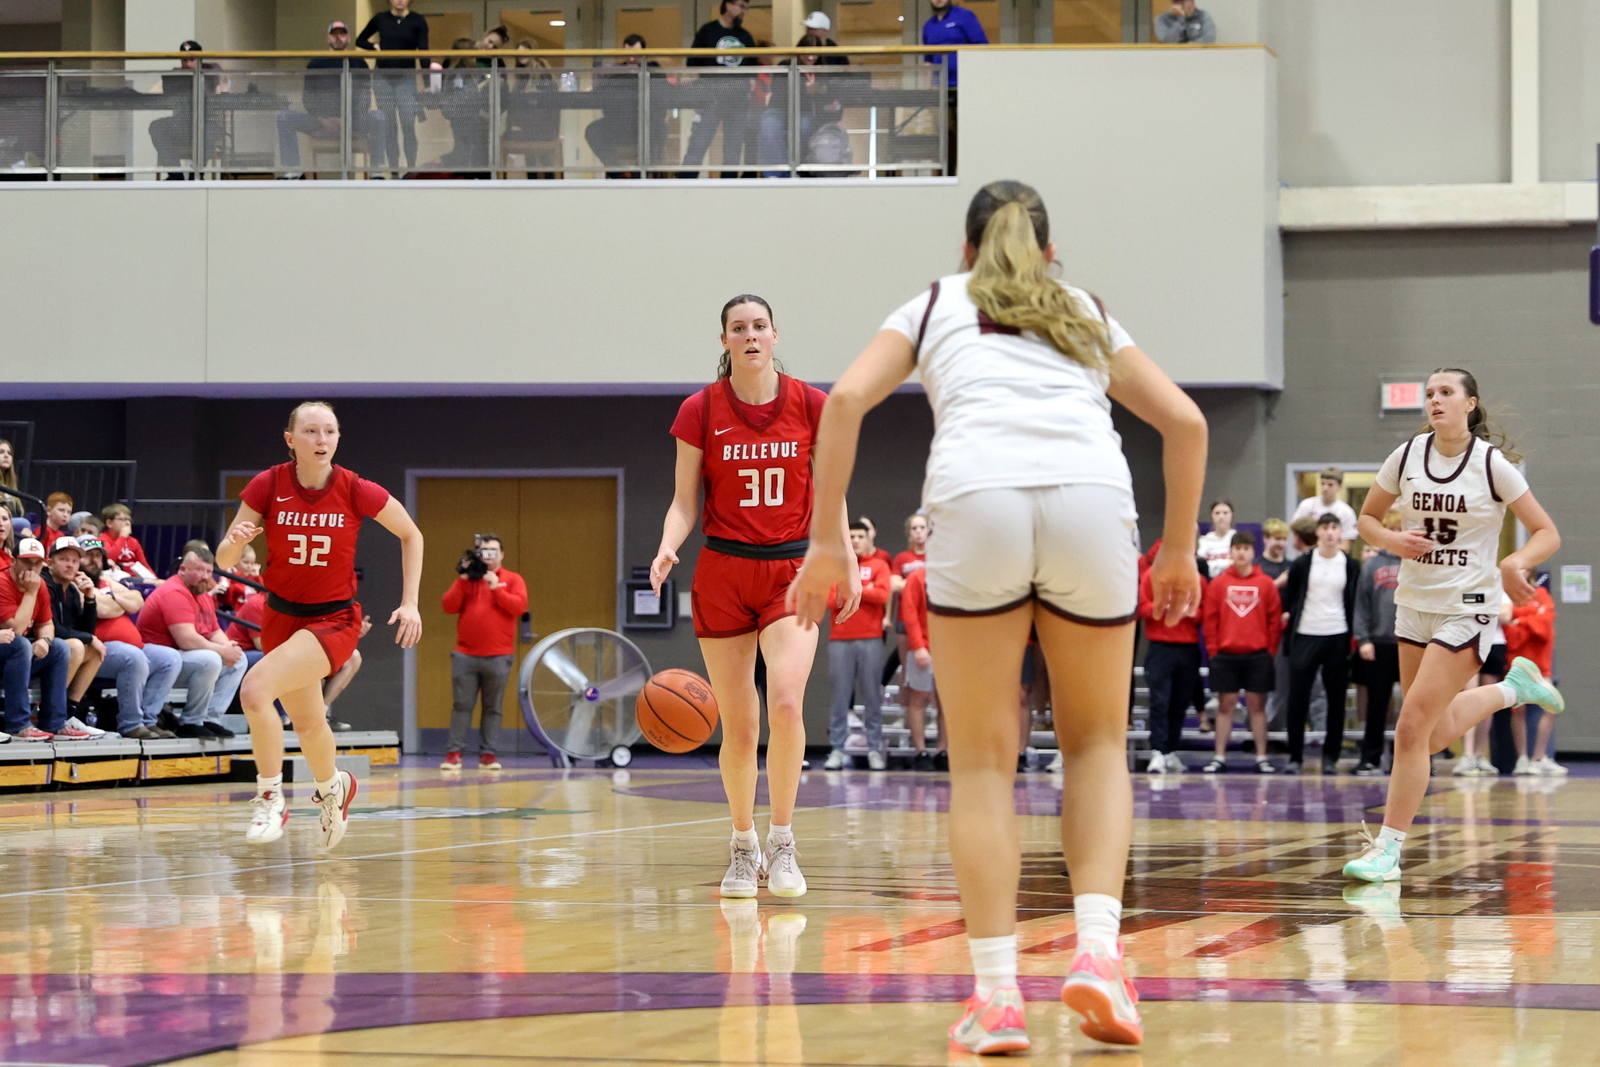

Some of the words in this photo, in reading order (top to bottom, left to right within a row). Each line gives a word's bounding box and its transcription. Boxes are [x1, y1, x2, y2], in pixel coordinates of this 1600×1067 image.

[723, 441, 799, 461] BELLEVUE
[738, 467, 785, 507] 30
[1412, 491, 1468, 513] GENOA
[276, 510, 345, 528] BELLEVUE
[1422, 517, 1459, 546] 15
[287, 533, 332, 567] 32
[1412, 549, 1469, 567] METS
